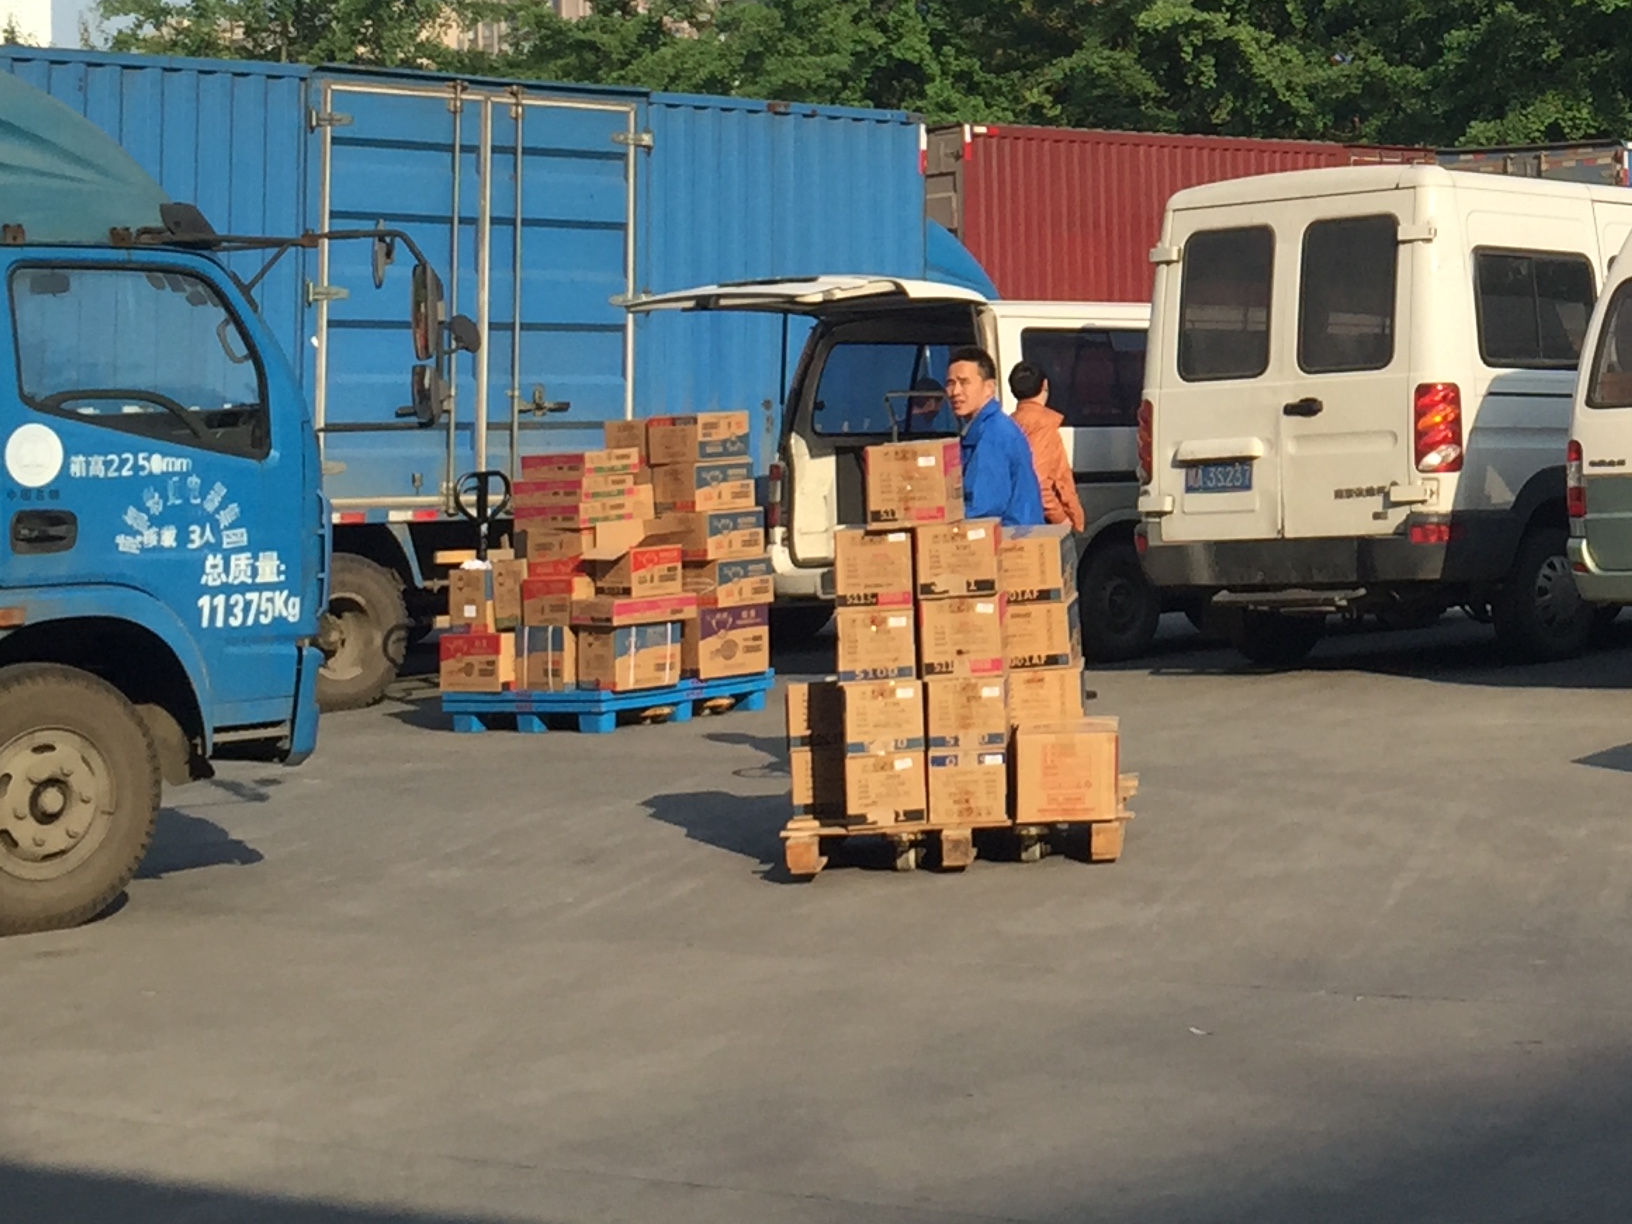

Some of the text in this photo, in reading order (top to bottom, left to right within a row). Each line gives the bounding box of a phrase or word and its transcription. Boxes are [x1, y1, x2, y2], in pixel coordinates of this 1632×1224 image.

[200, 550, 286, 587] 总质量:
[197, 589, 301, 628] 11375Kg
